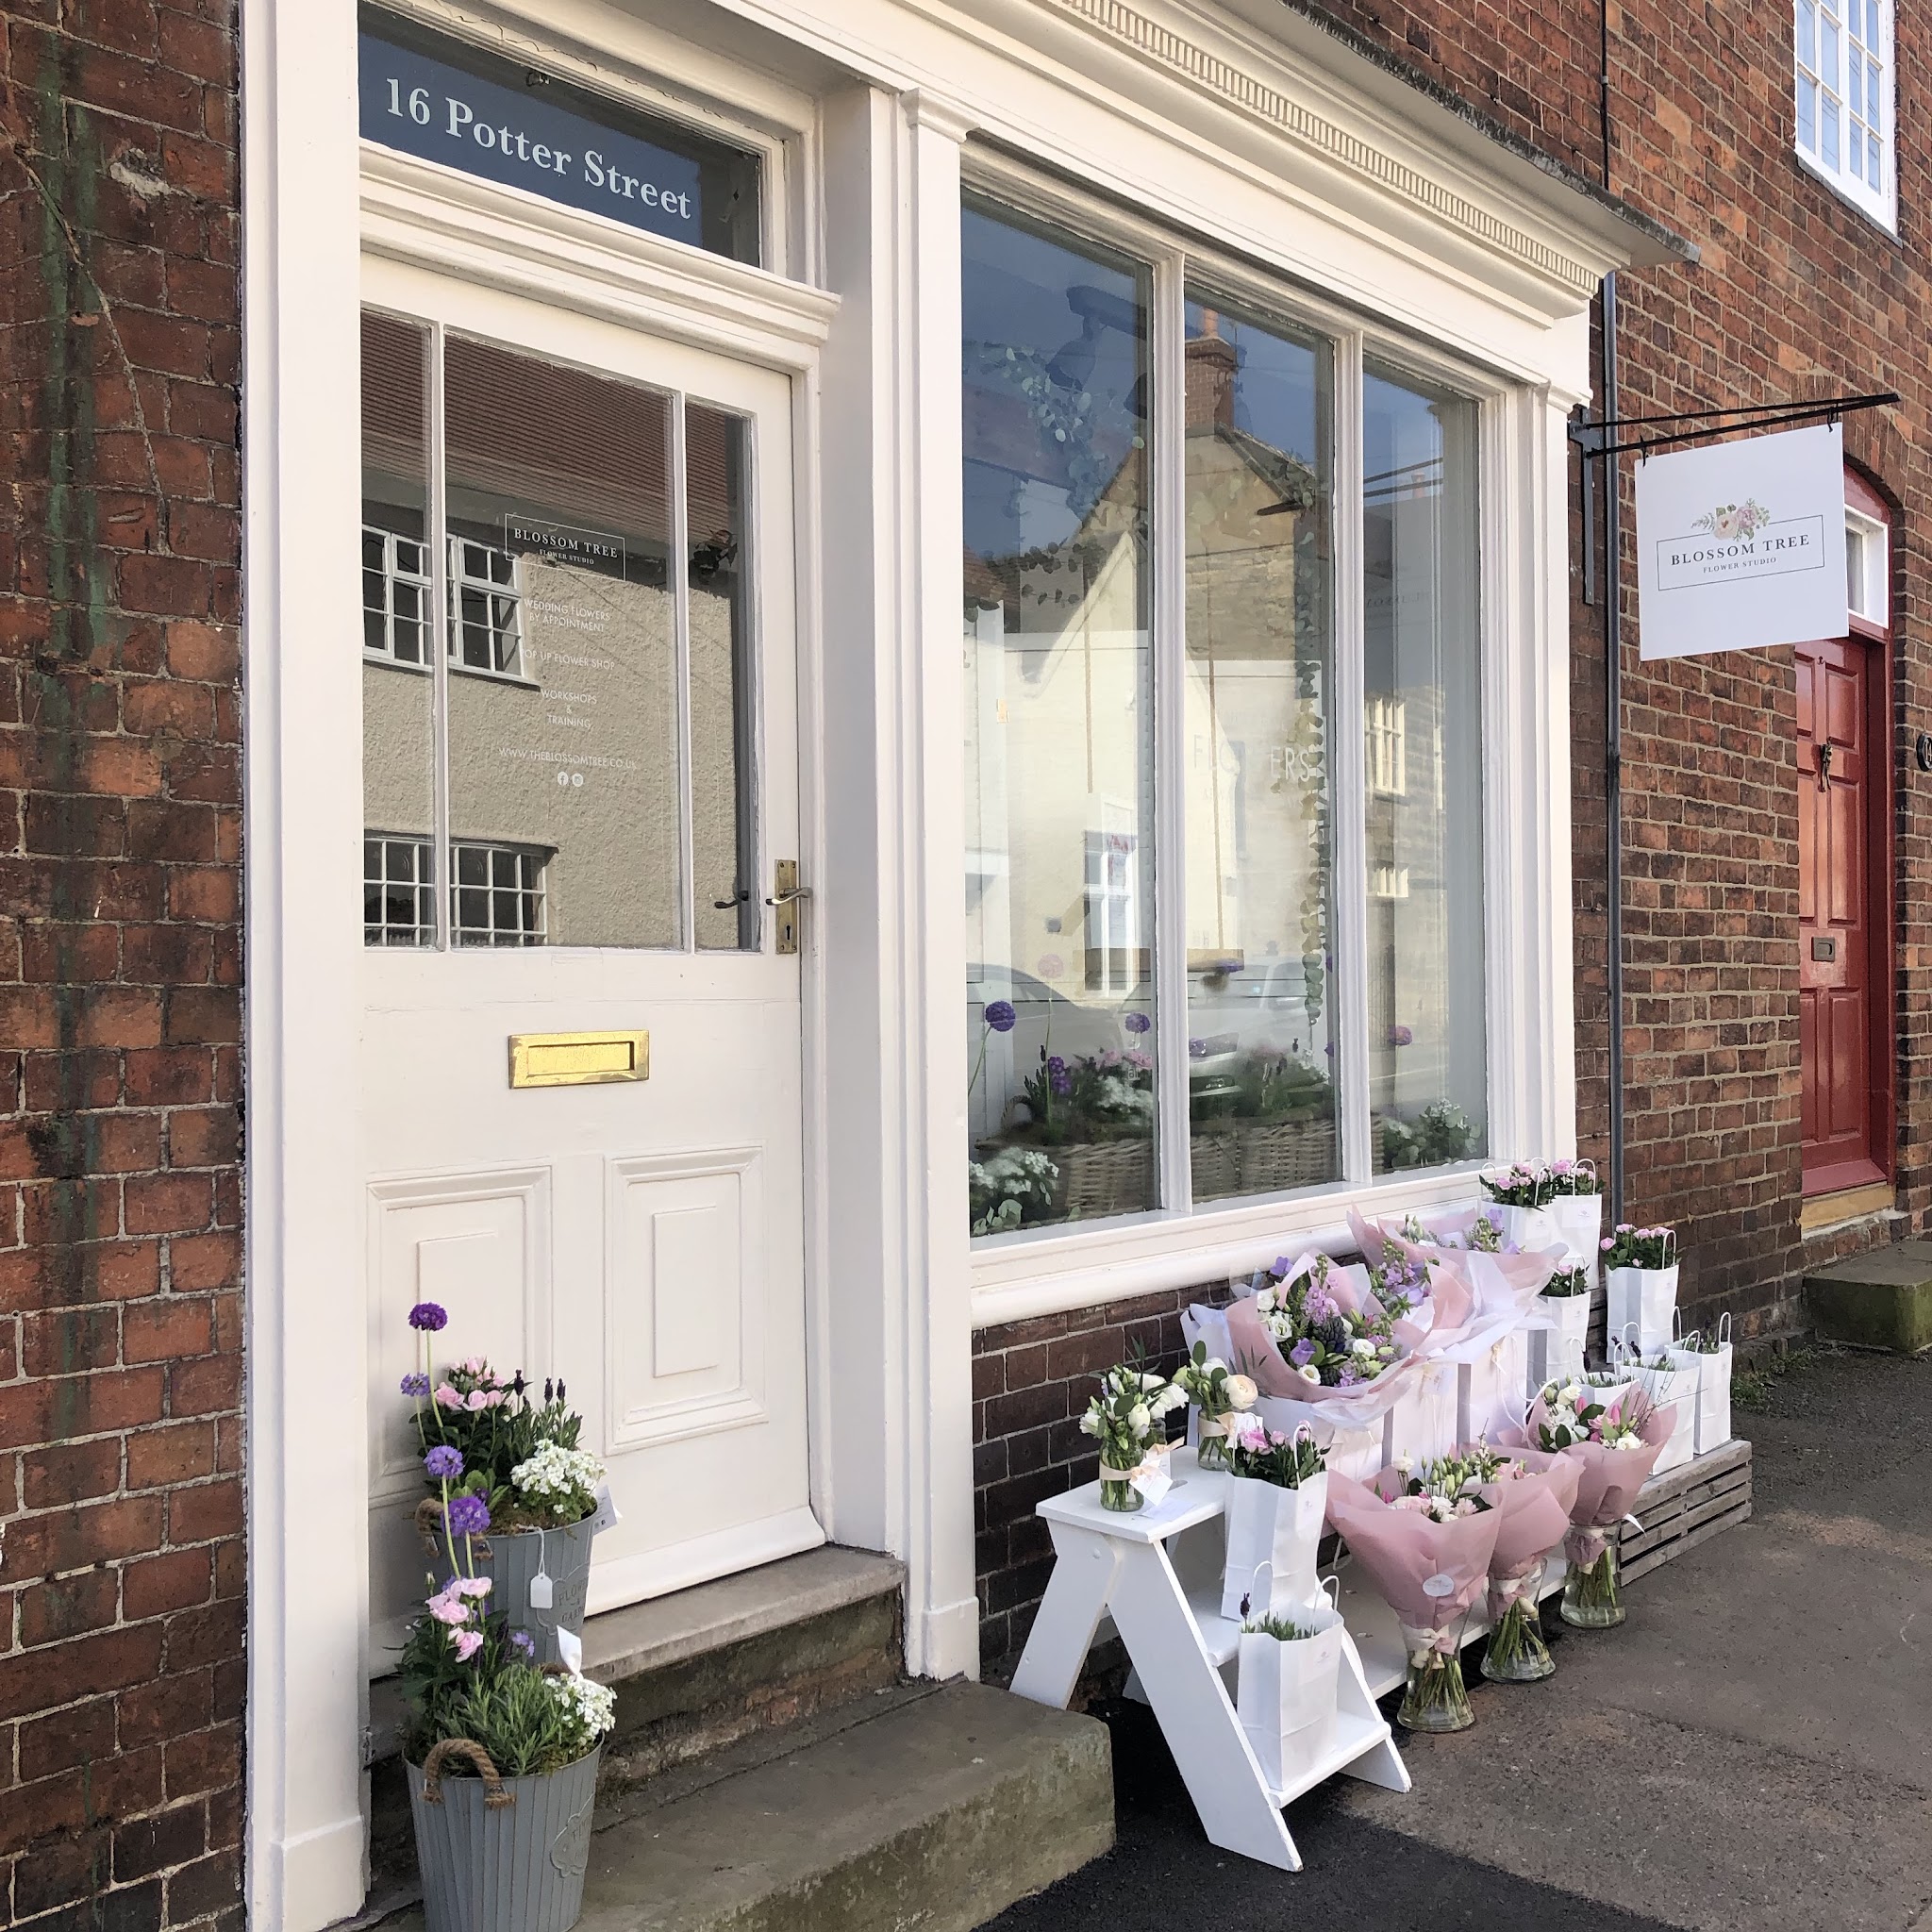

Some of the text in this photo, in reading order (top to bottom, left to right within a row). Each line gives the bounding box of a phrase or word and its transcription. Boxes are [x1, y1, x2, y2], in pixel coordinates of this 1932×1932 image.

[386, 77, 691, 220] 16 Potter Street
[514, 527, 618, 558] BLOSSOM TREE
[1671, 534, 1810, 566] BLOSSOM TREE
[539, 548, 594, 565] FLOWER STUDIO
[1703, 557, 1777, 574] FLOWER STUDIO
[524, 598, 611, 622] WEDDING FLOWERS
[529, 612, 605, 632] BY APPOINTMENT
[541, 651, 553, 661] UP
[554, 653, 590, 667] FLOWER
[591, 658, 615, 671] SHOP
[541, 690, 597, 704] WORKSHOPS
[546, 714, 591, 729] TRAINING
